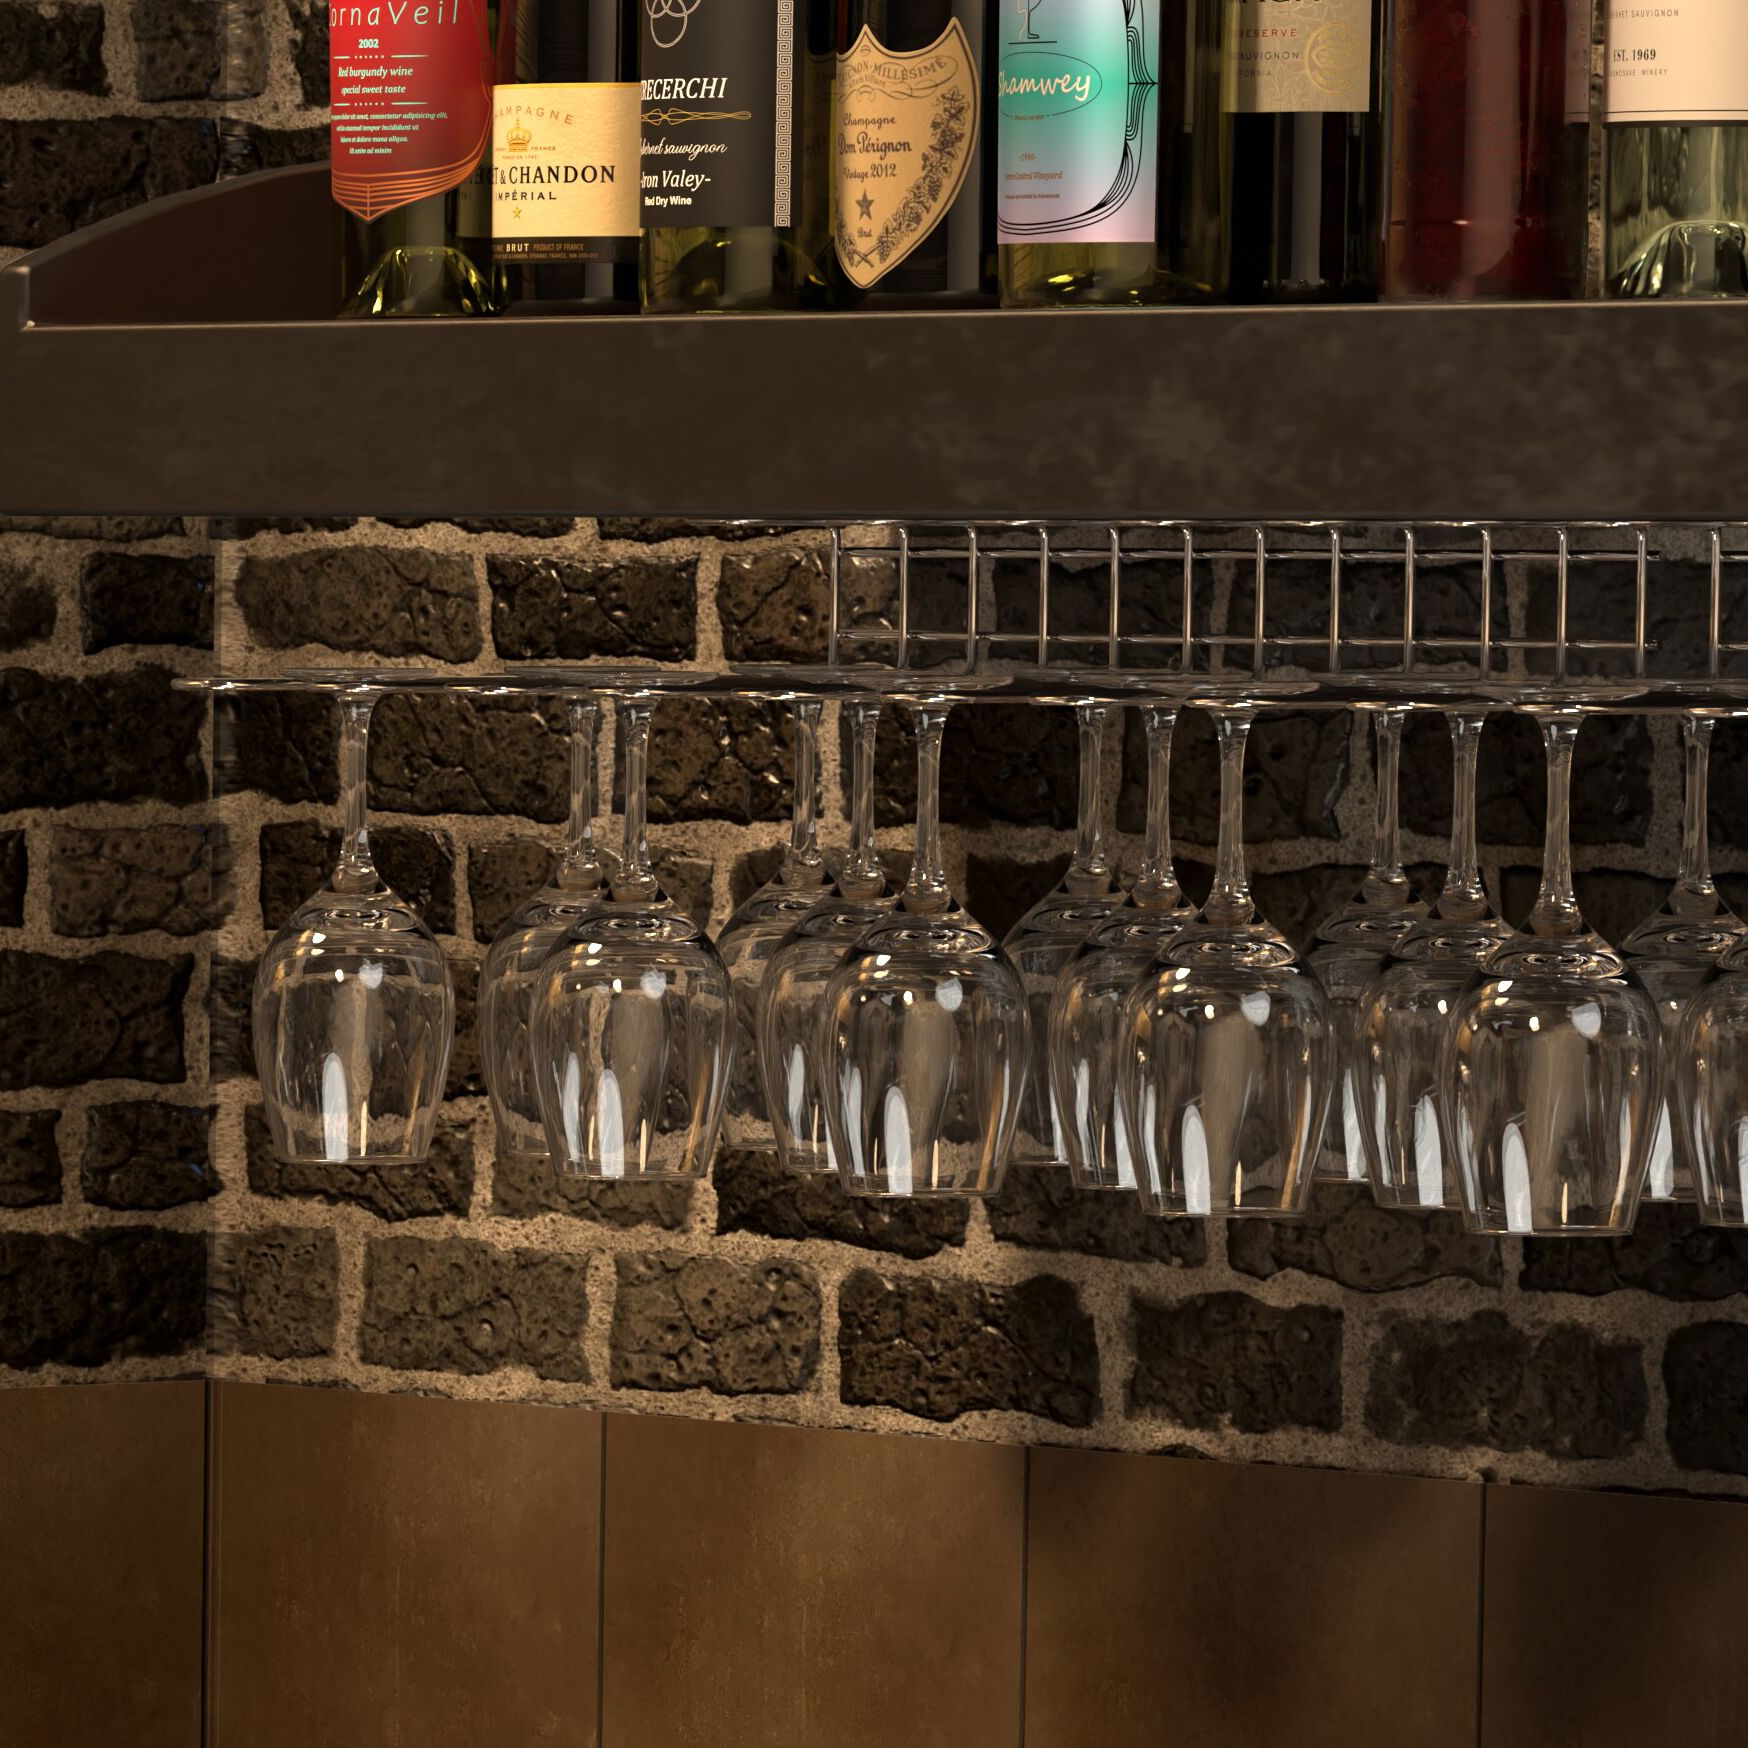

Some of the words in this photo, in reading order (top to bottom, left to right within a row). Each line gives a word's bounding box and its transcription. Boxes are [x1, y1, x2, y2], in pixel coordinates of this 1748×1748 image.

[1631, 9, 1679, 18] SAUVIGNON
[359, 39, 379, 48] 2002
[1613, 49, 1629, 62] EST.
[1632, 48, 1656, 61] 1969
[349, 66, 388, 79] burgundy
[390, 66, 413, 76] wine
[362, 85, 382, 94] sweet
[385, 85, 406, 94] taste
[999, 71, 1091, 101] Shamwey
[844, 114, 896, 129] Champagne
[664, 142, 728, 161] sauvignon
[838, 132, 856, 155] Dom
[857, 131, 912, 160] Pérignon
[509, 165, 616, 184] CHANDON
[843, 167, 869, 183] Vintage
[871, 163, 897, 178] 2012
[662, 169, 711, 192] Valey-
[655, 196, 668, 208] Dry
[669, 196, 692, 205] Wine
[506, 243, 530, 252] BRUT
